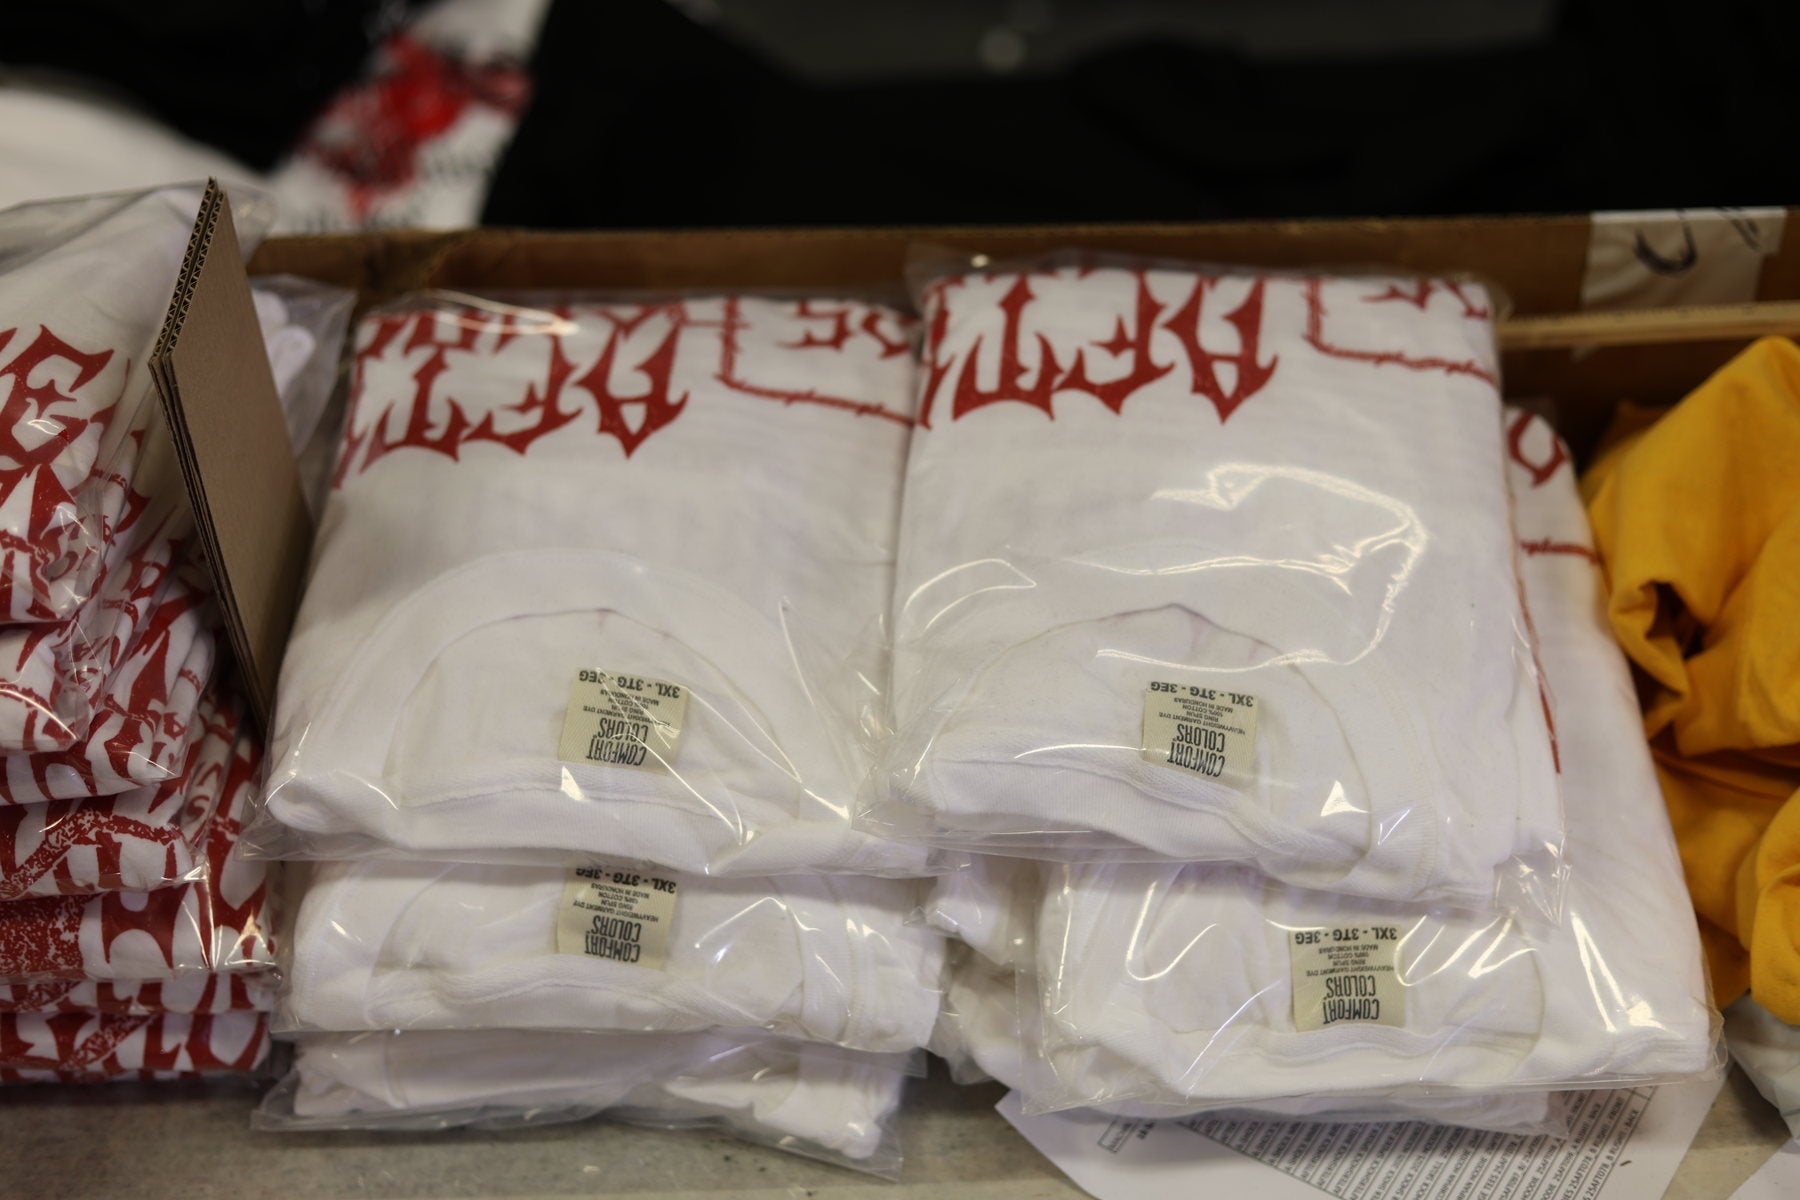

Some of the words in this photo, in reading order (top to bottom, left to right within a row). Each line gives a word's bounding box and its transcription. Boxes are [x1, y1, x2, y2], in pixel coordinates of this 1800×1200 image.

[579, 670, 606, 684] 3EG
[617, 676, 644, 691] 3TG
[656, 683, 680, 698] 3XL
[1151, 682, 1177, 693] 3EG
[1190, 687, 1216, 700] 3TG
[643, 697, 659, 705] MADE
[1174, 698, 1207, 707] HONDURAS
[1229, 693, 1254, 707] 3XL
[1183, 704, 1207, 713] COTTON
[1216, 705, 1233, 713] MADE
[1173, 715, 1201, 725] GARMENT
[1203, 721, 1245, 735] HEAVYWEIGHT
[586, 738, 647, 766] COMFORT
[1167, 742, 1225, 777] COMFORT
[613, 873, 640, 886] 3TG
[651, 878, 676, 893] 3XL
[591, 883, 624, 893] HONDURAS
[598, 892, 623, 901] COTTON
[586, 904, 615, 914] GARMENT
[616, 910, 658, 922] HEAVYWEIGHT
[1295, 932, 1320, 944] 3EG
[1333, 929, 1359, 941] 3TG
[1372, 927, 1397, 940] 3XL
[584, 935, 640, 962] COMFORT
[1323, 999, 1380, 1024] COMFORT
